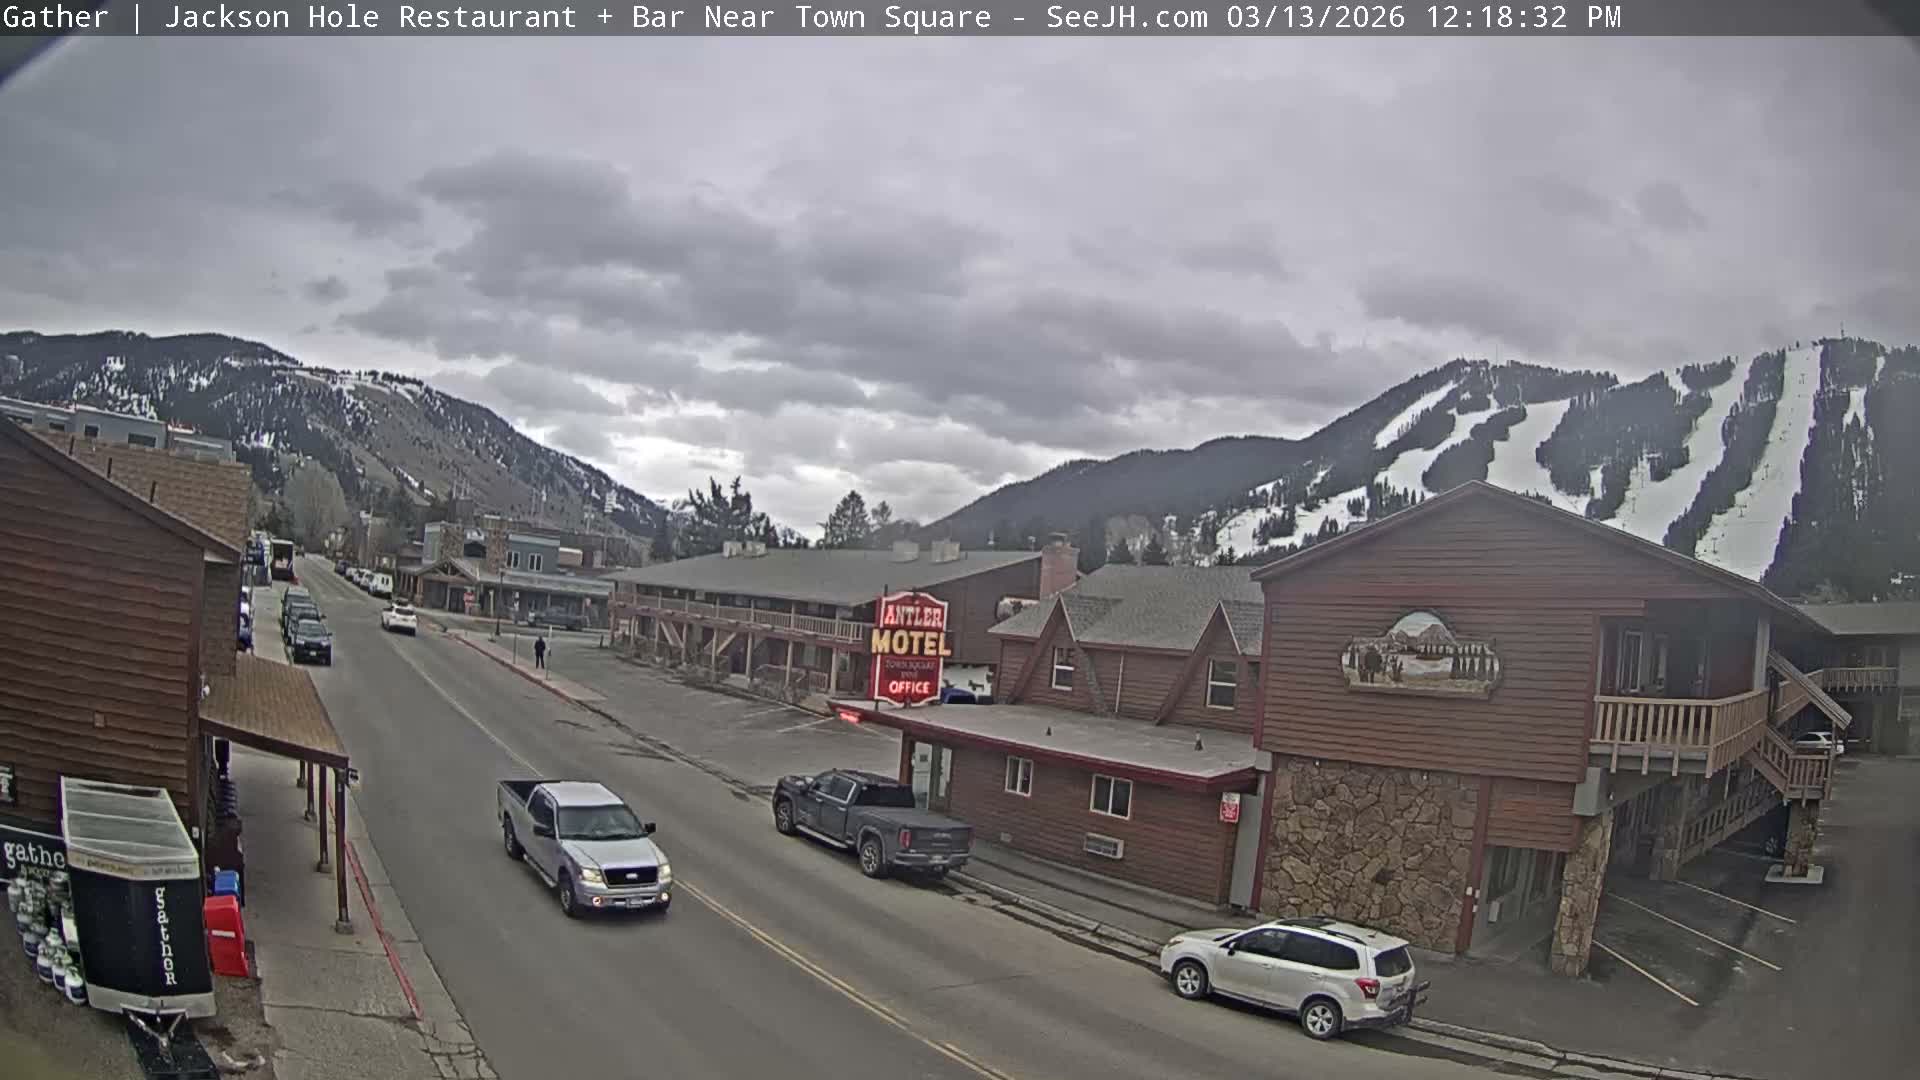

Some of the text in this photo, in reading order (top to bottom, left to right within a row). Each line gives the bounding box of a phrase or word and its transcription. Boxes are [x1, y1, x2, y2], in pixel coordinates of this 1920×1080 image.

[884, 604, 942, 627] ANTLER
[871, 628, 951, 656] MOTEL
[889, 680, 931, 694] OFFICE
[4, 841, 66, 869] gathe
